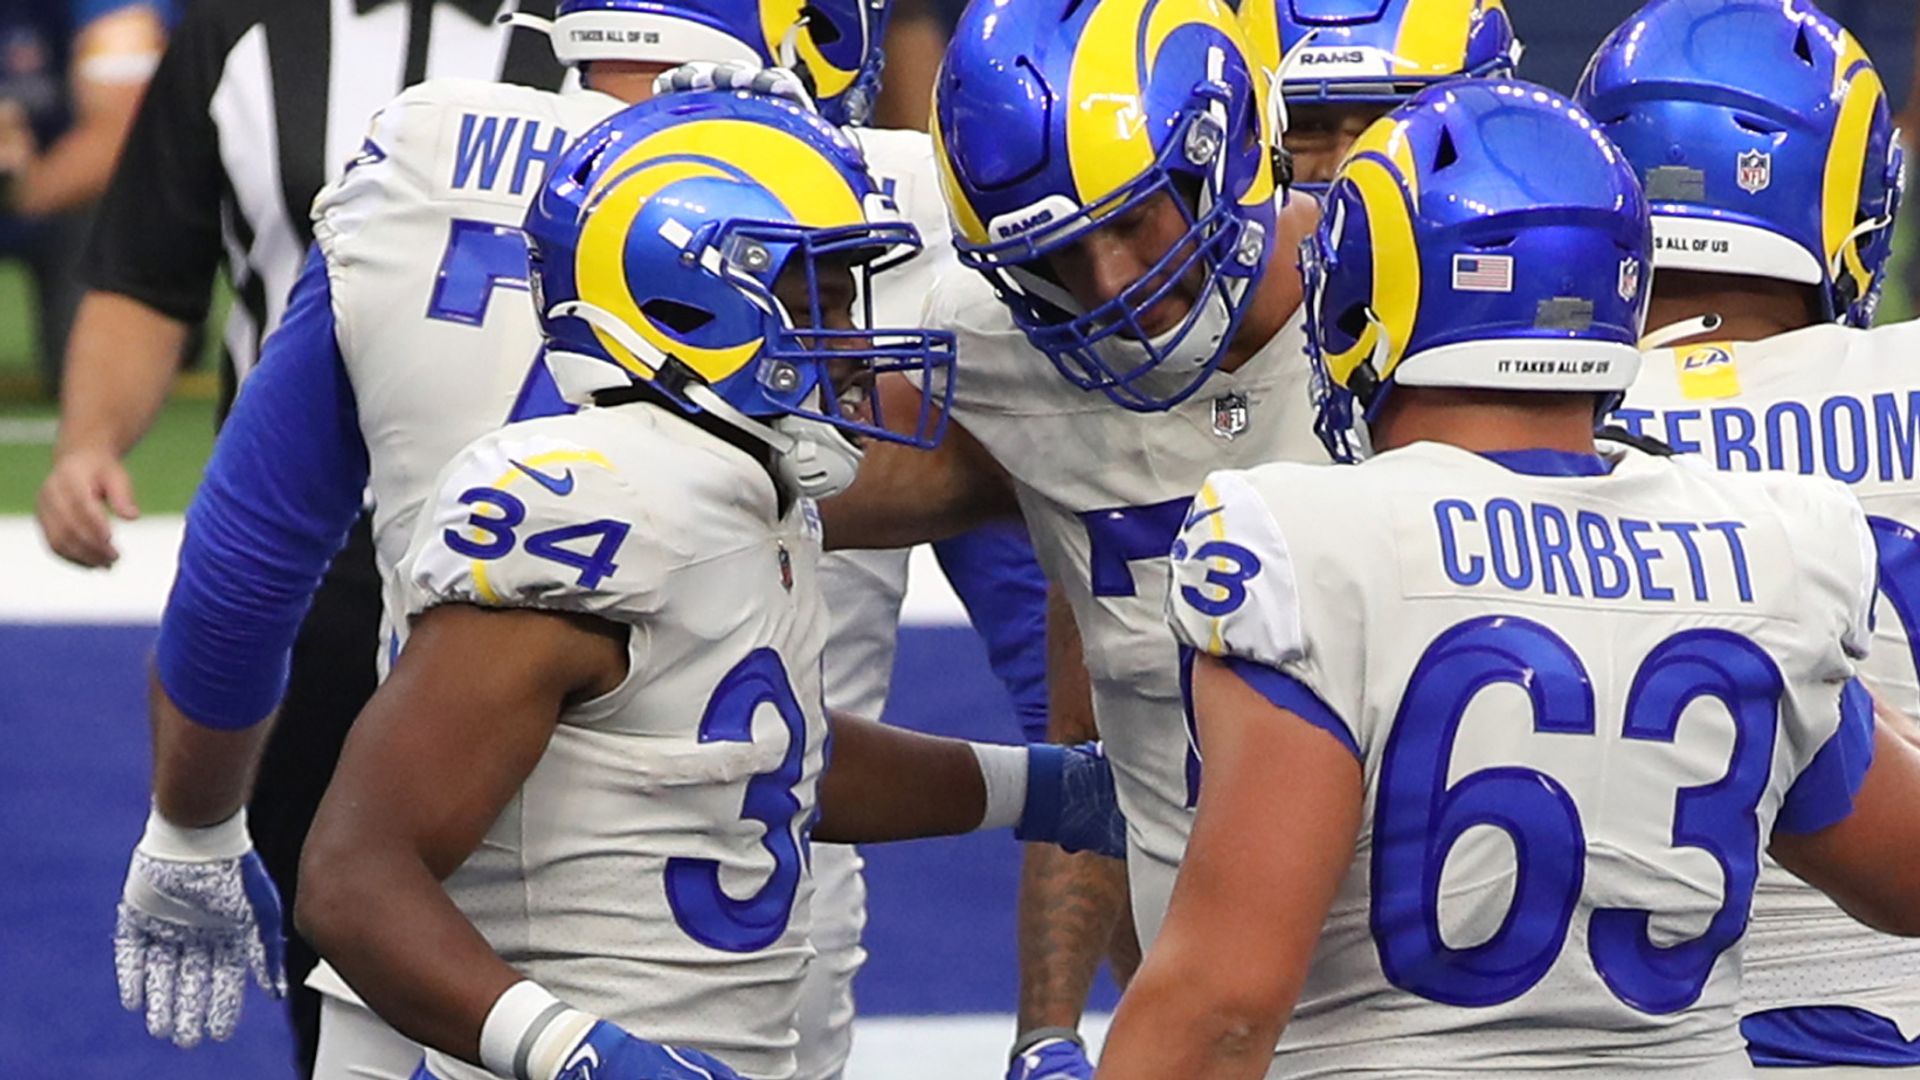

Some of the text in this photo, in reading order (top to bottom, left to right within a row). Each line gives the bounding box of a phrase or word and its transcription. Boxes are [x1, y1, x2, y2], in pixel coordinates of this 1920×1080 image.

[606, 31, 624, 42] ALL
[627, 31, 640, 43] OF
[644, 32, 659, 44] US
[1300, 51, 1364, 65] RAMS
[998, 209, 1054, 239] RAMS
[1667, 237, 1689, 251] ALL
[1692, 239, 1708, 252] OF
[1711, 240, 1729, 253] US
[1499, 359, 1511, 373] IT
[1514, 359, 1556, 374] TAKES
[1558, 360, 1577, 374] ALL
[1580, 360, 1595, 374] OF
[1684, 347, 1729, 370] LA
[444, 486, 632, 590] 34
[1433, 497, 1754, 602] CORBETT
[664, 646, 832, 953] 3
[1372, 614, 1785, 1014] 63
